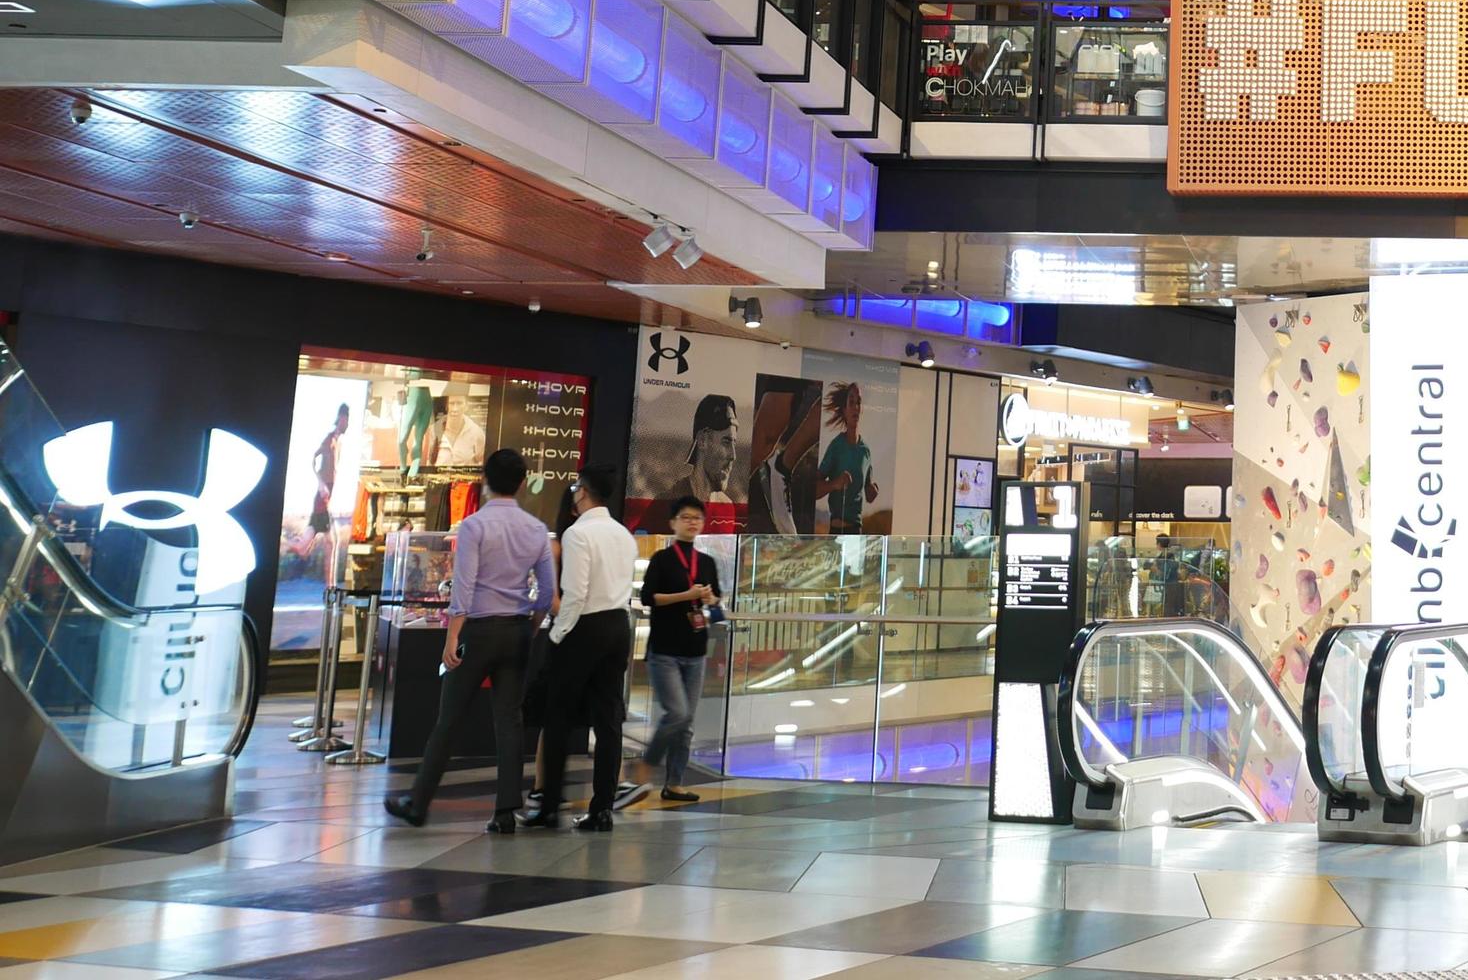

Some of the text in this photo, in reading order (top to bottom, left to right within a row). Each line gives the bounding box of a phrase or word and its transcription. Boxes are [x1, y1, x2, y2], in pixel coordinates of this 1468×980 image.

[926, 44, 967, 65] Play
[925, 76, 1029, 98] CHOKMAH
[642, 377, 691, 389] UNDER ARMOUR
[1410, 365, 1444, 527] central
